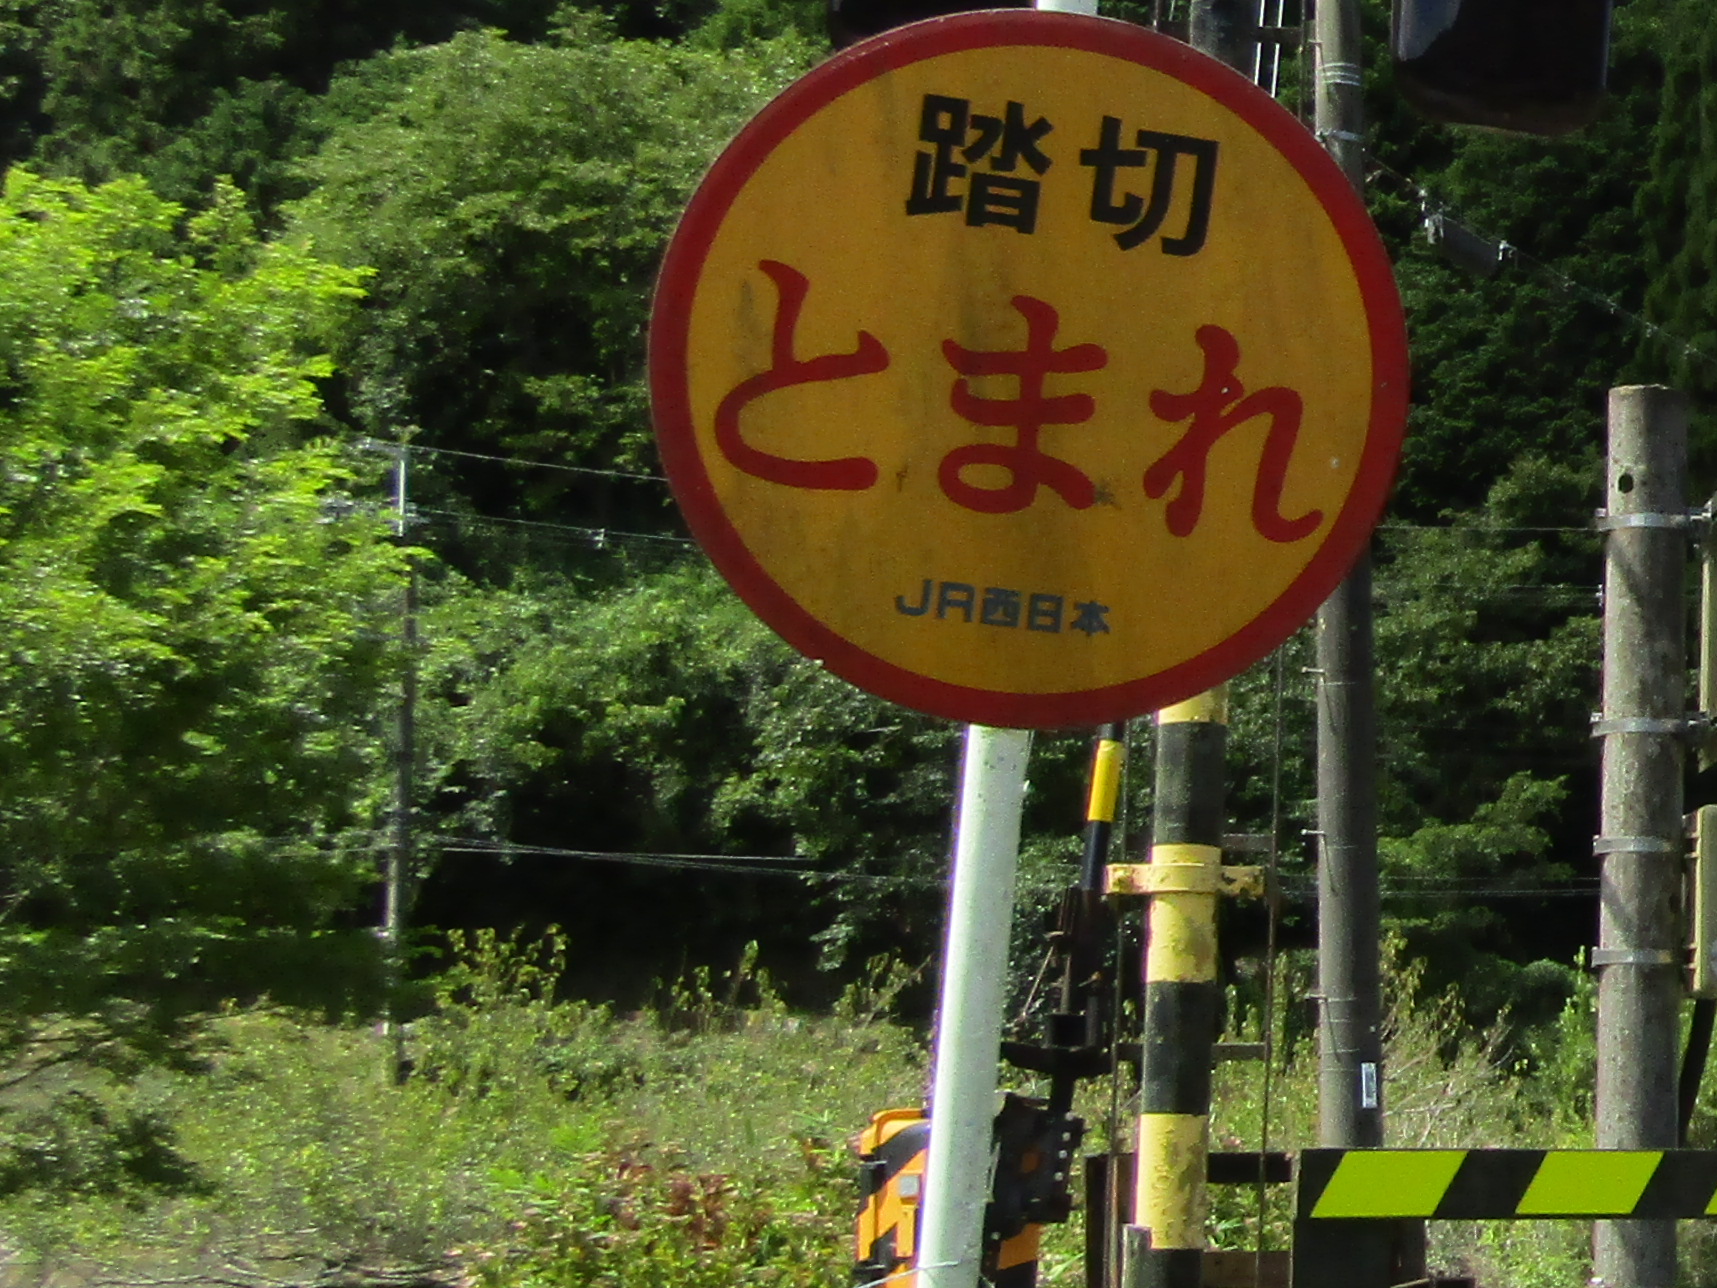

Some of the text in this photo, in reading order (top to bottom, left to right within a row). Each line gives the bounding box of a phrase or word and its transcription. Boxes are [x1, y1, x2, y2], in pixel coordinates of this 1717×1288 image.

[904, 92, 1221, 257] 踏切
[713, 259, 1325, 544] とまれ
[894, 578, 1111, 638] JR西日本
